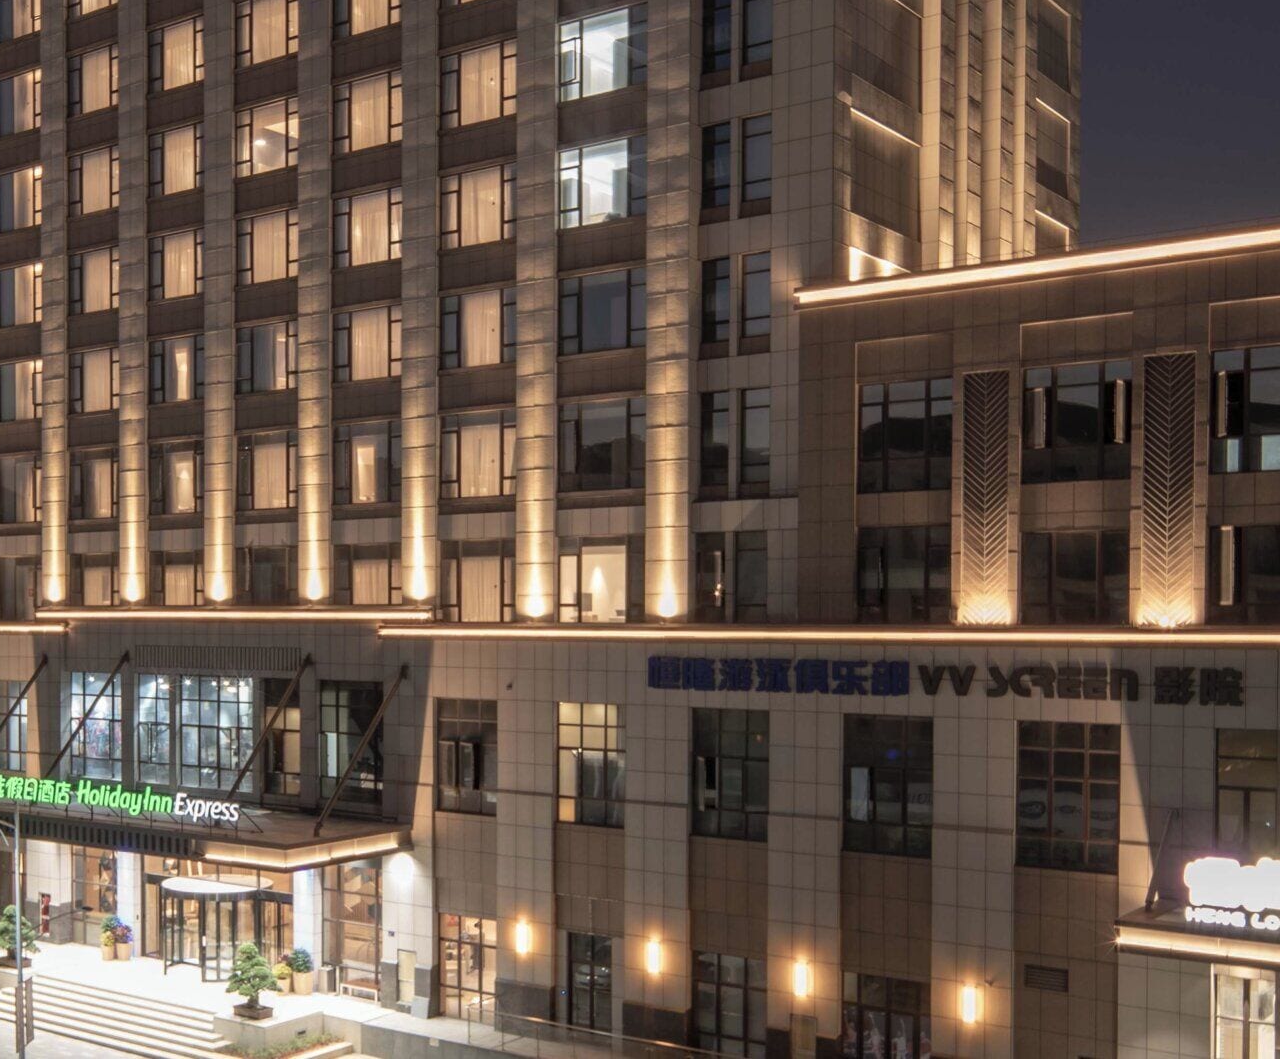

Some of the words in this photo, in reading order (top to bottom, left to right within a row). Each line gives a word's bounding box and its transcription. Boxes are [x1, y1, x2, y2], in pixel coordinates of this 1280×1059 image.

[1153, 666, 1244, 706] 影院
[77, 779, 144, 816] Holiday
[143, 786, 173, 814] Inn
[174, 792, 240, 822] Express
